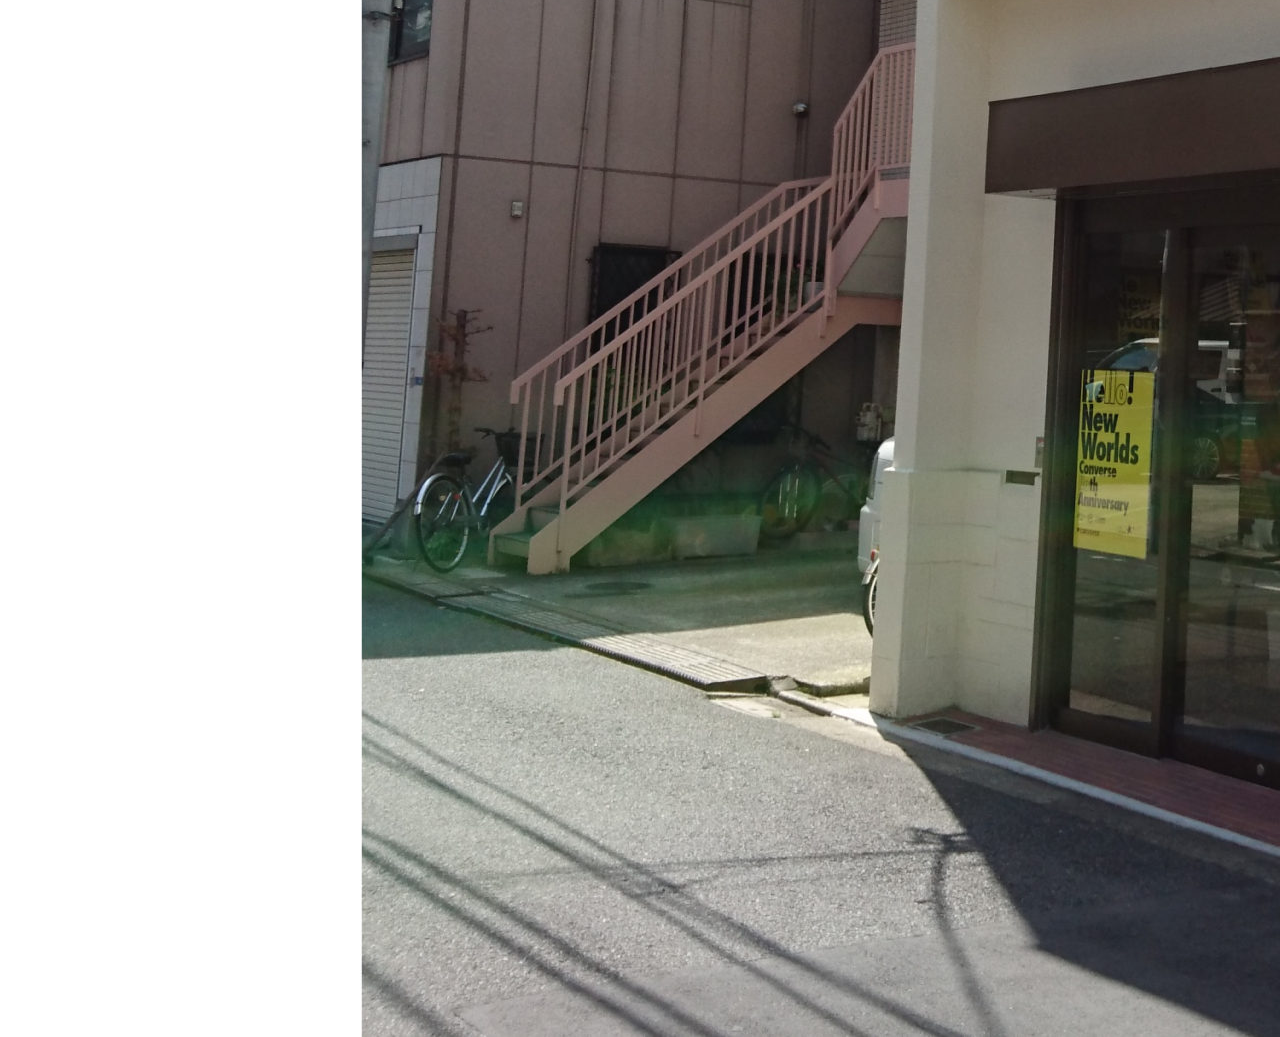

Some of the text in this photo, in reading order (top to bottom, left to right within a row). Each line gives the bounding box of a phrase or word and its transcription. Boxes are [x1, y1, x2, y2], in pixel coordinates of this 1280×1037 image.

[1081, 370, 1134, 405] Hello!
[1081, 403, 1118, 433] New
[1080, 431, 1139, 465] Worlds
[1079, 460, 1117, 478] Converse
[1078, 492, 1129, 516] Anniversary
